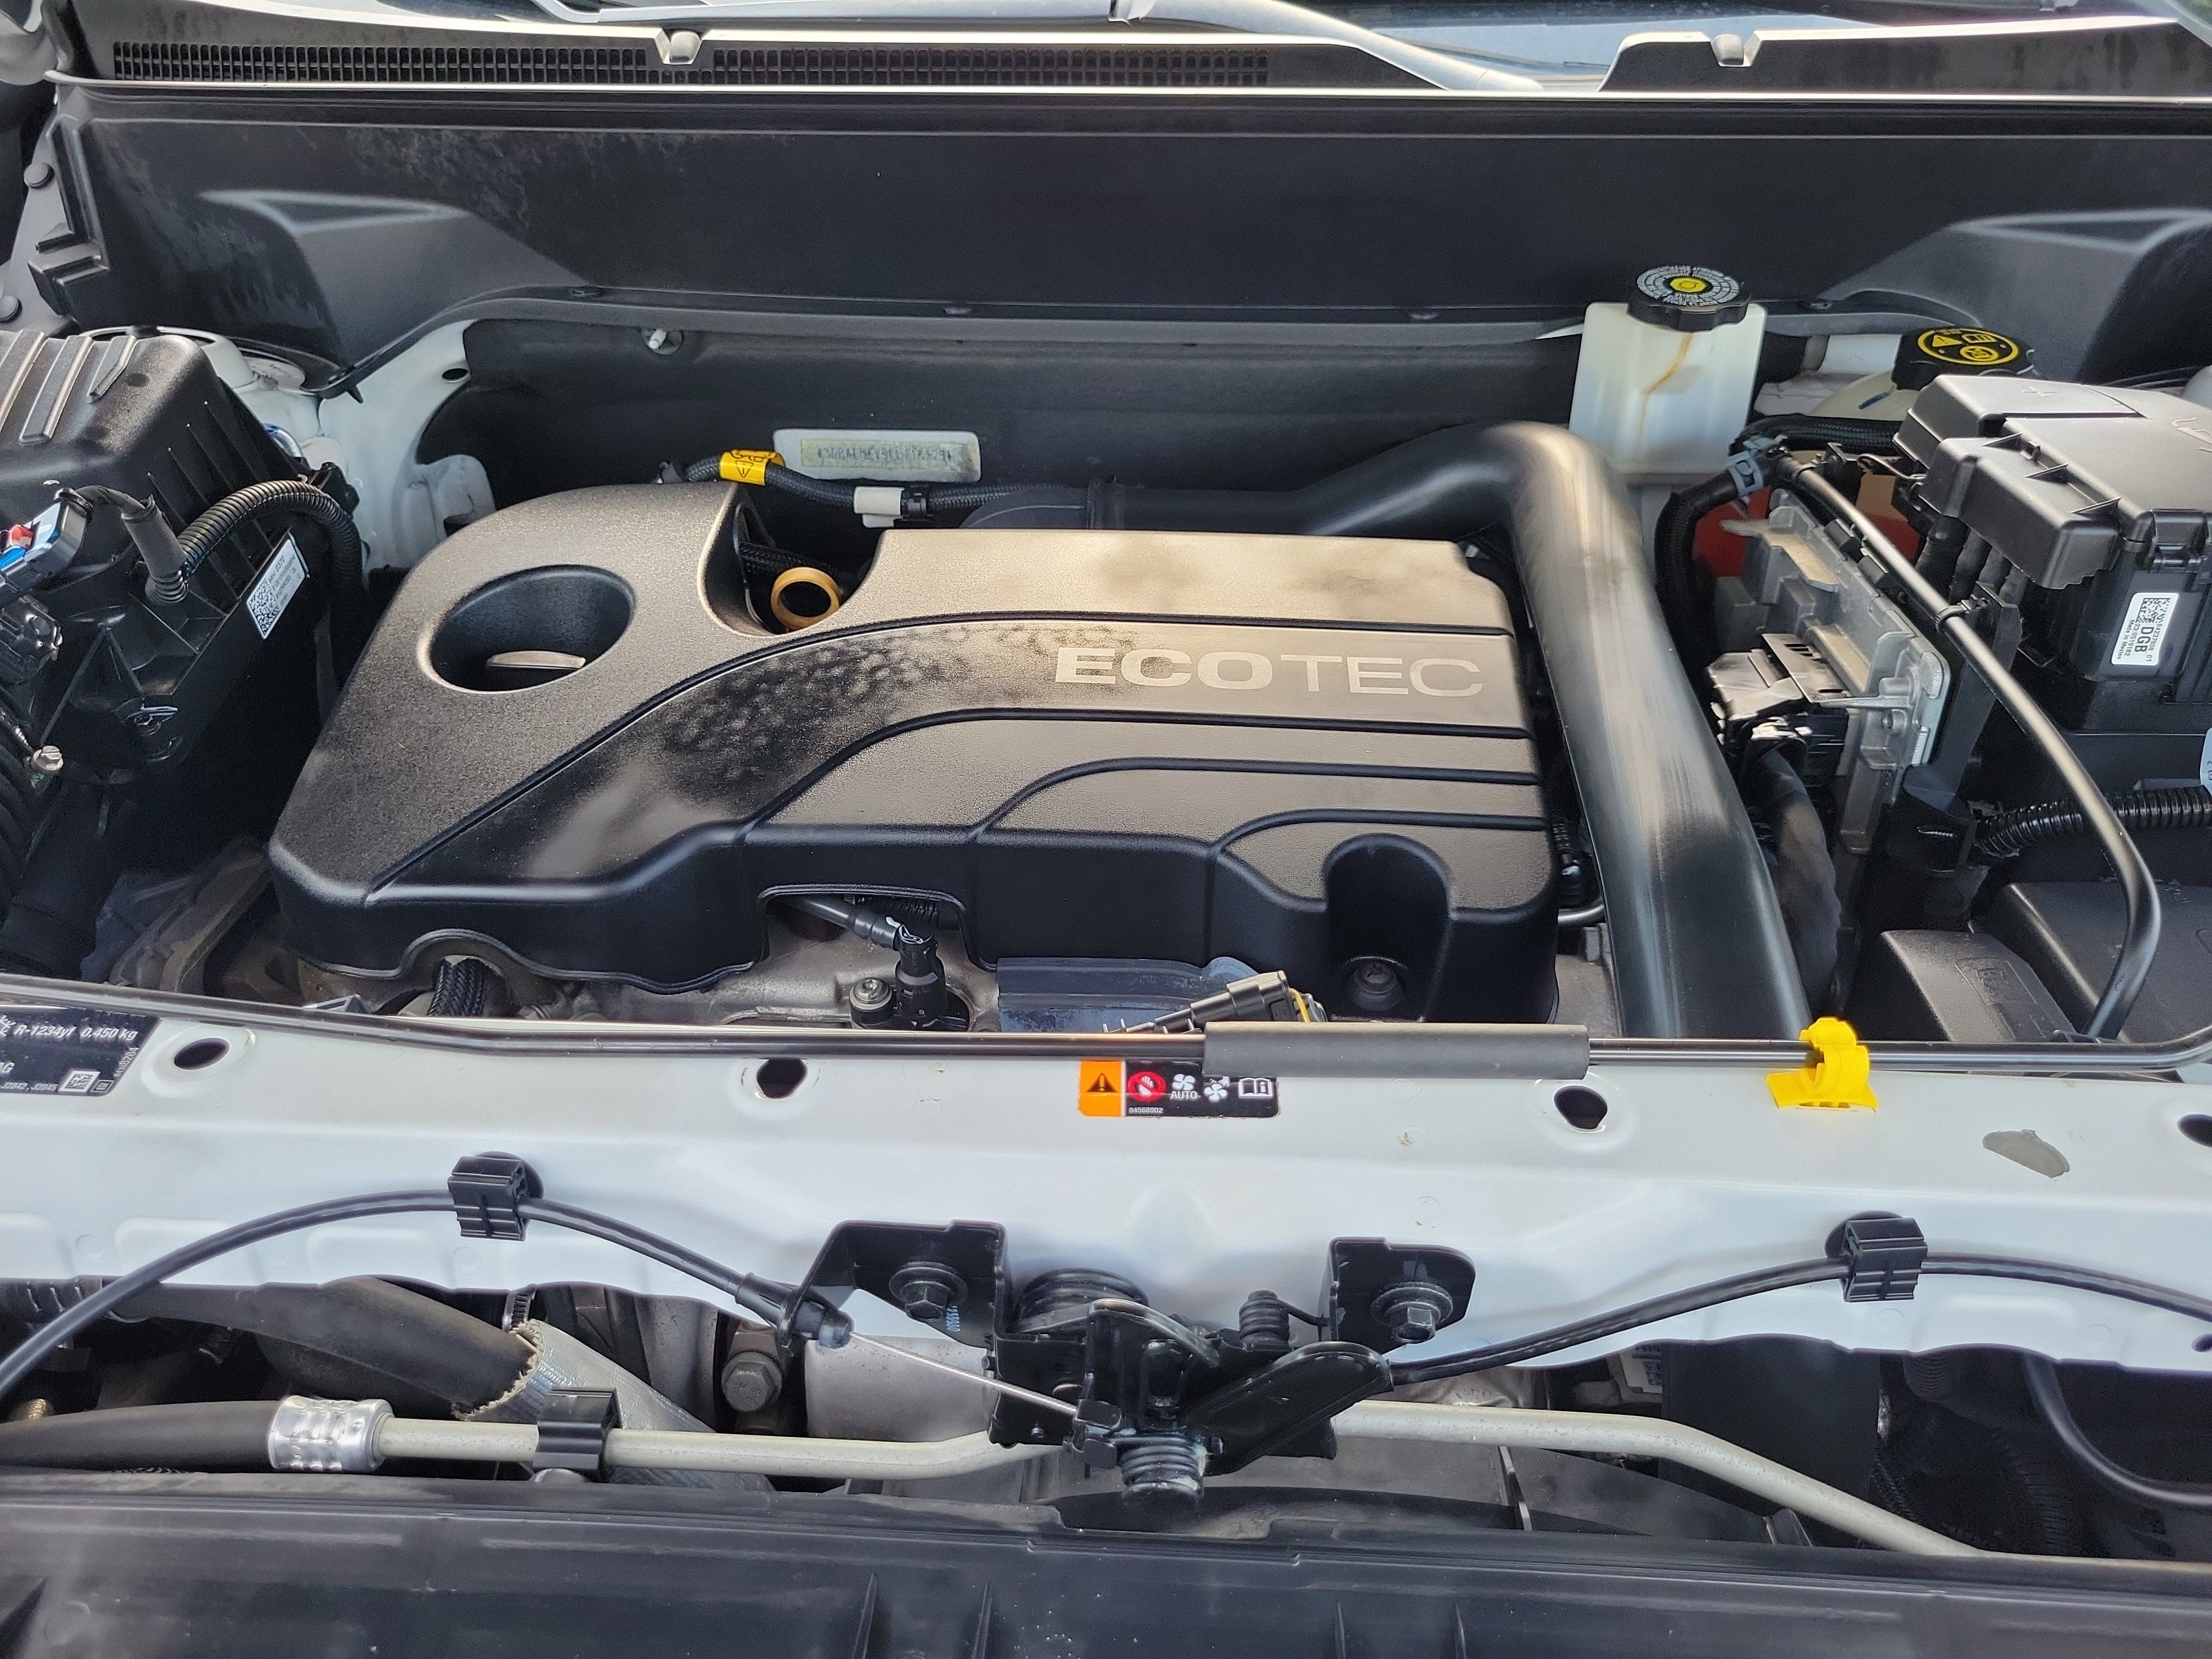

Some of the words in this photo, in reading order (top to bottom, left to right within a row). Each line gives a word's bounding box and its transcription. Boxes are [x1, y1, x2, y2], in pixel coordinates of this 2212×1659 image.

[2125, 620, 2135, 634] Made
[2134, 627, 2154, 652] DGB
[2117, 641, 2128, 659] Mexico
[1055, 647, 1483, 697] ECOTEC
[13, 1024, 77, 1039] R-1234yf
[119, 1028, 139, 1041] kg
[1170, 1091, 1197, 1099] AUTO
